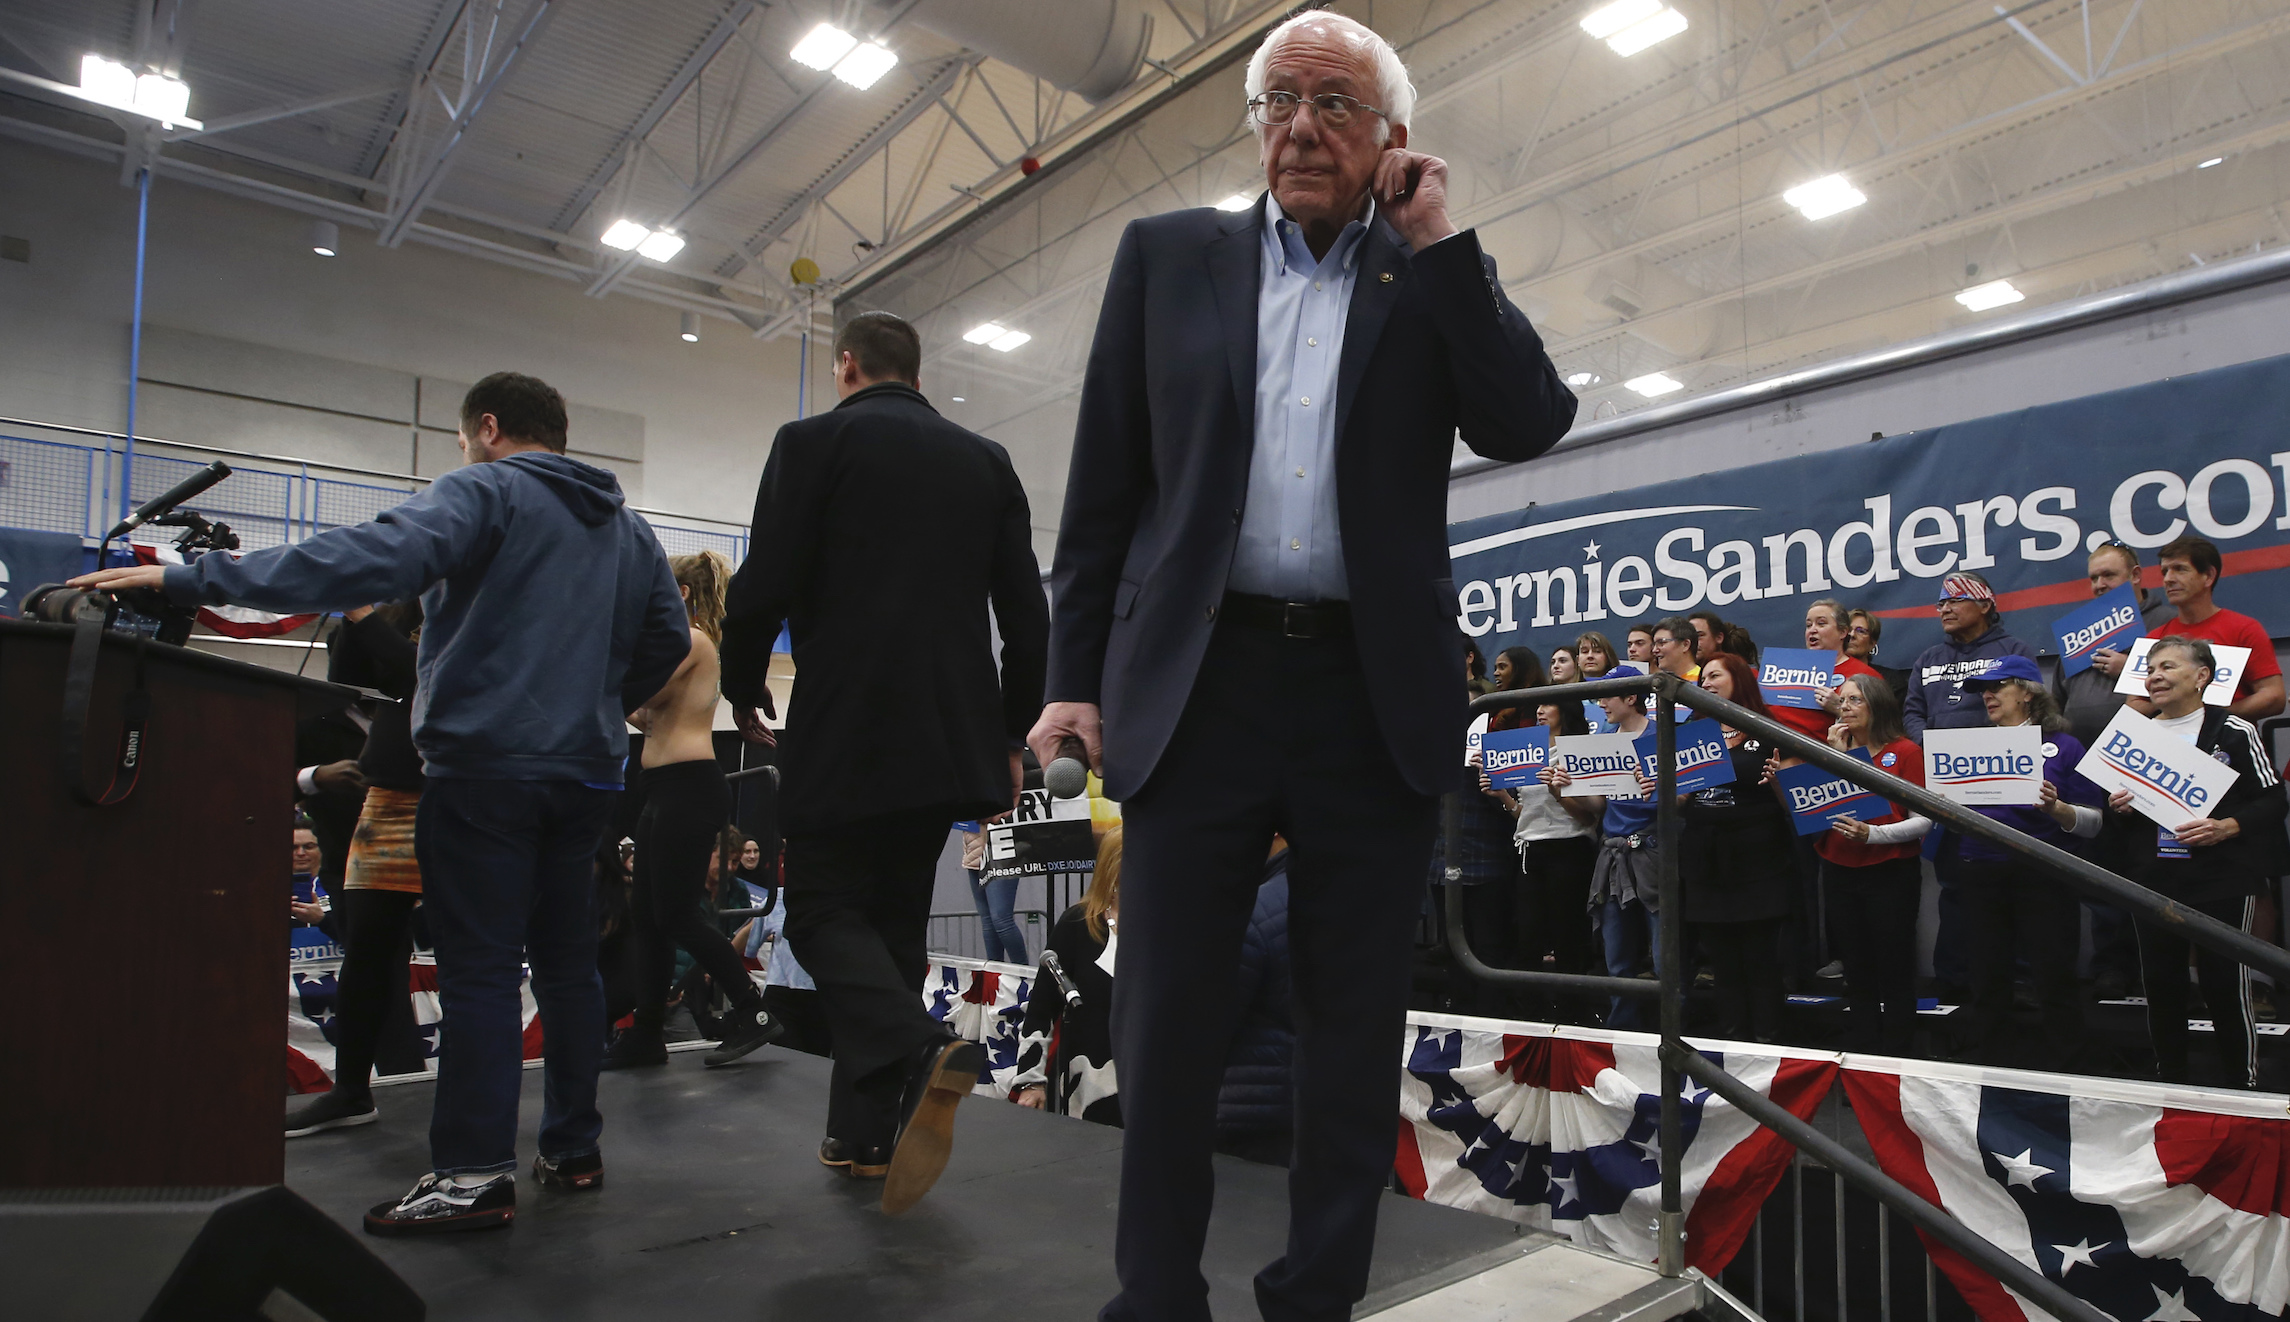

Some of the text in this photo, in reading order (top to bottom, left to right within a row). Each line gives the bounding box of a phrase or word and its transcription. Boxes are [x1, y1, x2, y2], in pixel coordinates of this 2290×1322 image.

[1456, 450, 2290, 638] ernieSanders.co
[2061, 605, 2135, 654] Bernie
[1762, 664, 1827, 688] Bernie
[123, 731, 139, 767] Canon
[1485, 743, 1544, 769] Bernie
[1564, 751, 1636, 773] Bernie
[1644, 739, 1722, 777] Brnie
[1932, 748, 2033, 777] Bernie
[2102, 730, 2208, 808] Bernie
[1789, 779, 1864, 809] Bern
[1024, 862, 1047, 873] URL:
[290, 940, 345, 960] ernie
